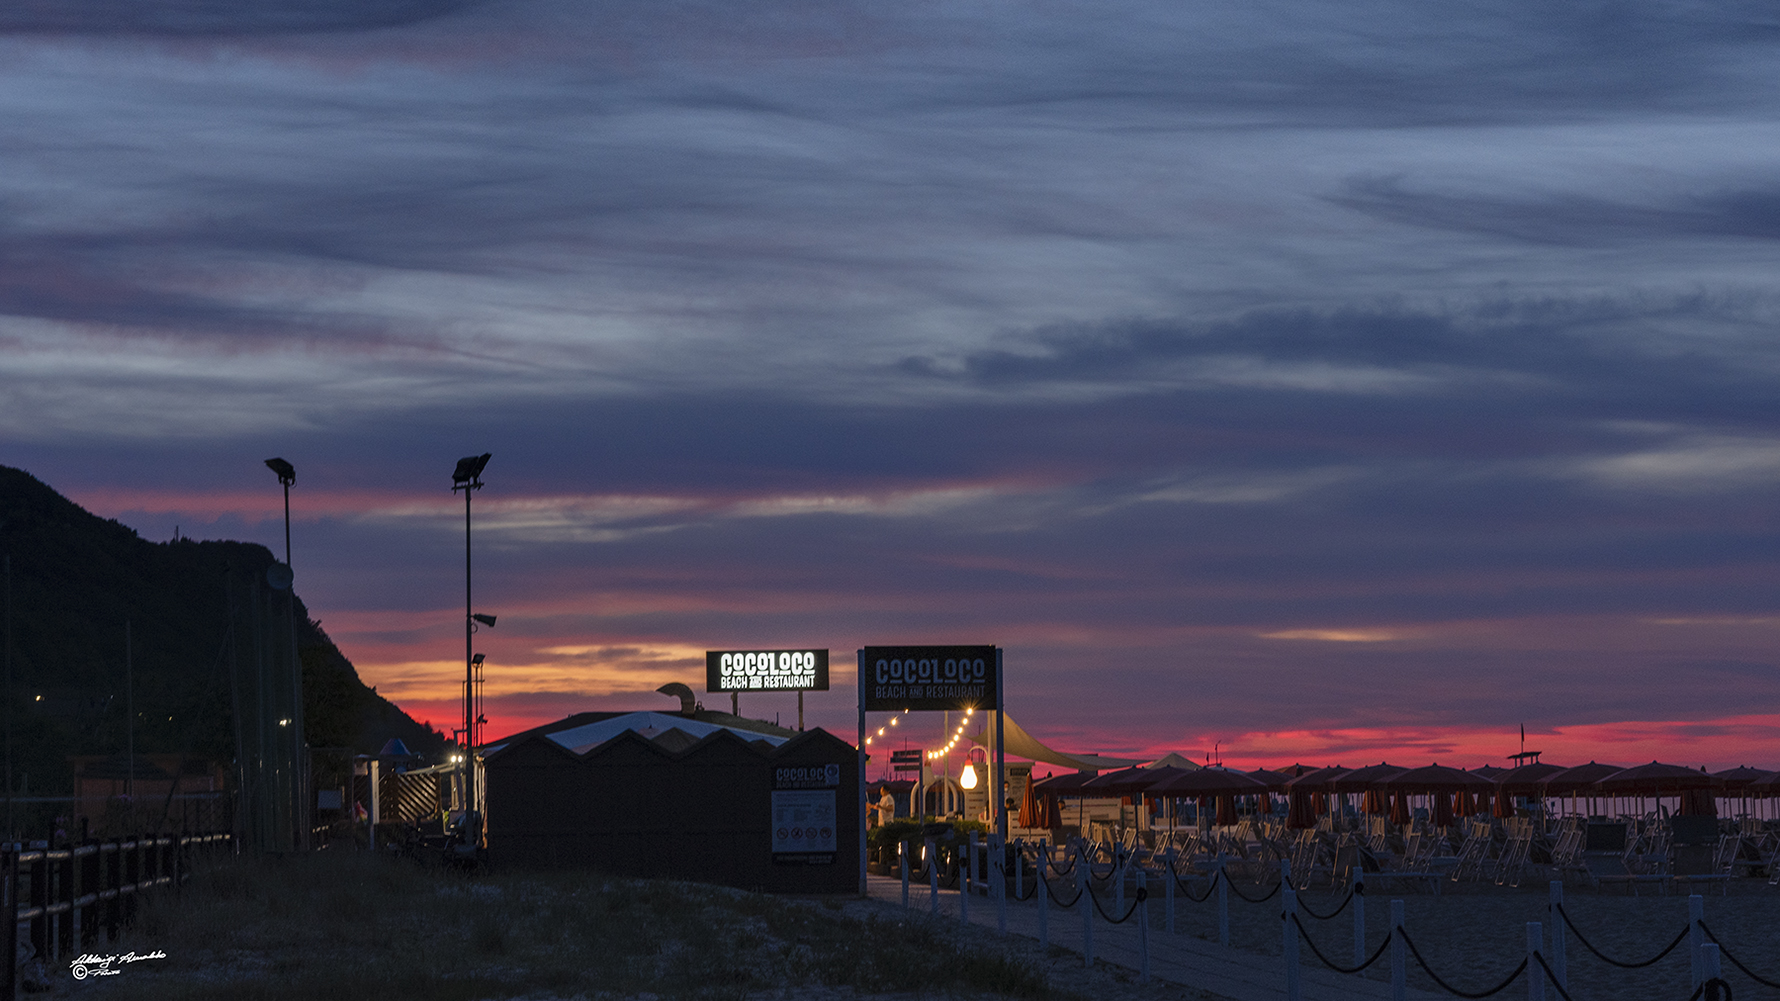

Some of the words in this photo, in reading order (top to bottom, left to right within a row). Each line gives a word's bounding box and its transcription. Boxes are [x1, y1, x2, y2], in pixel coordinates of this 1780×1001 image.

[721, 676, 748, 689] BEACH
[764, 675, 815, 688] RESTAURANT
[876, 686, 906, 699] BEACH
[909, 686, 923, 698] AND
[926, 685, 985, 698] RESTAURANT
[776, 767, 826, 781] COCOLOC
